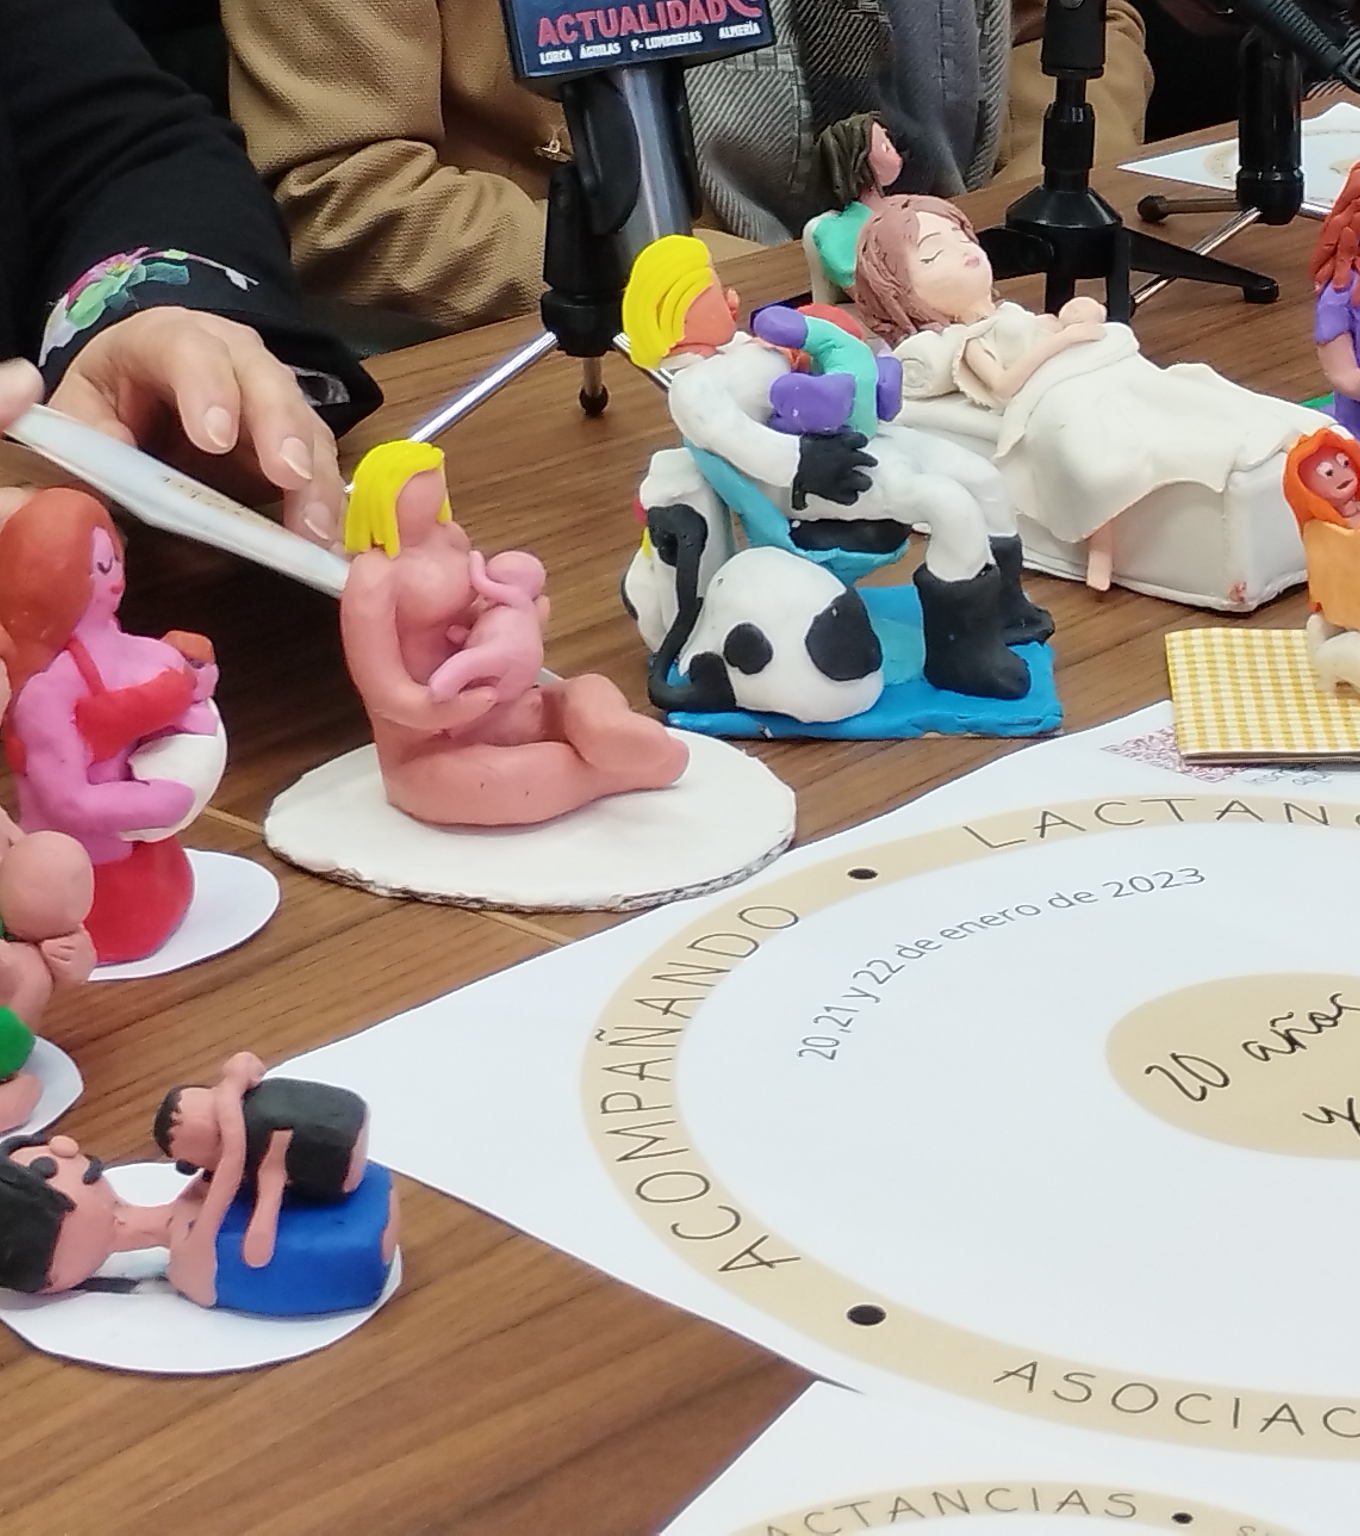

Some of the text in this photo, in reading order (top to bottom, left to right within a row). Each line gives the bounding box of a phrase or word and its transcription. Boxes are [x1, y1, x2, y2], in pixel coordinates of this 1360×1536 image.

[1102, 867, 1206, 899] 2023
[1048, 891, 1100, 910] de
[939, 902, 1042, 941] enero
[896, 937, 942, 960] de
[853, 959, 905, 985] 22
[842, 986, 881, 1004] y
[595, 905, 801, 1273] ACOMPAÑANDO
[1145, 1052, 1230, 1103] 20
